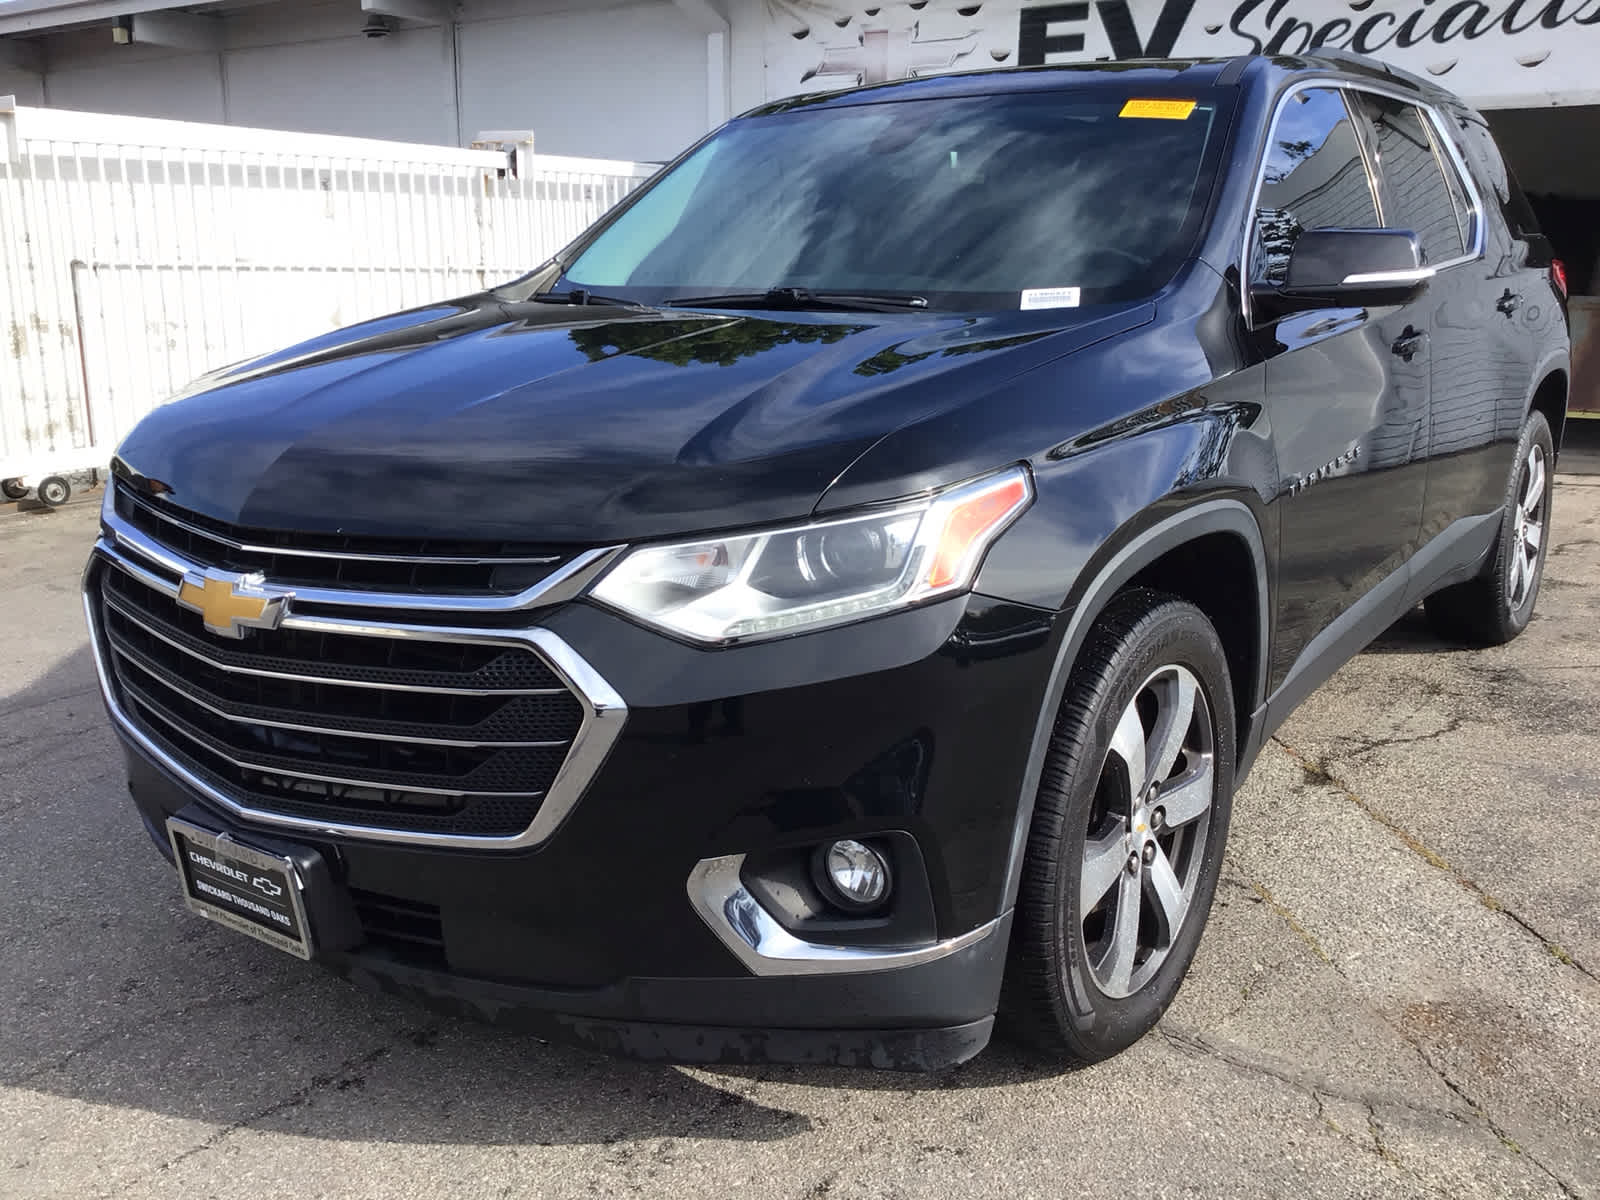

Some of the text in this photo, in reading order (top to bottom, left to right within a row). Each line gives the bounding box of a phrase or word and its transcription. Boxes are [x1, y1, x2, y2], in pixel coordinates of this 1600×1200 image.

[189, 851, 248, 883] CHEVROLET
[231, 894, 271, 918] THOUSAND
[270, 909, 291, 927] OAKS
